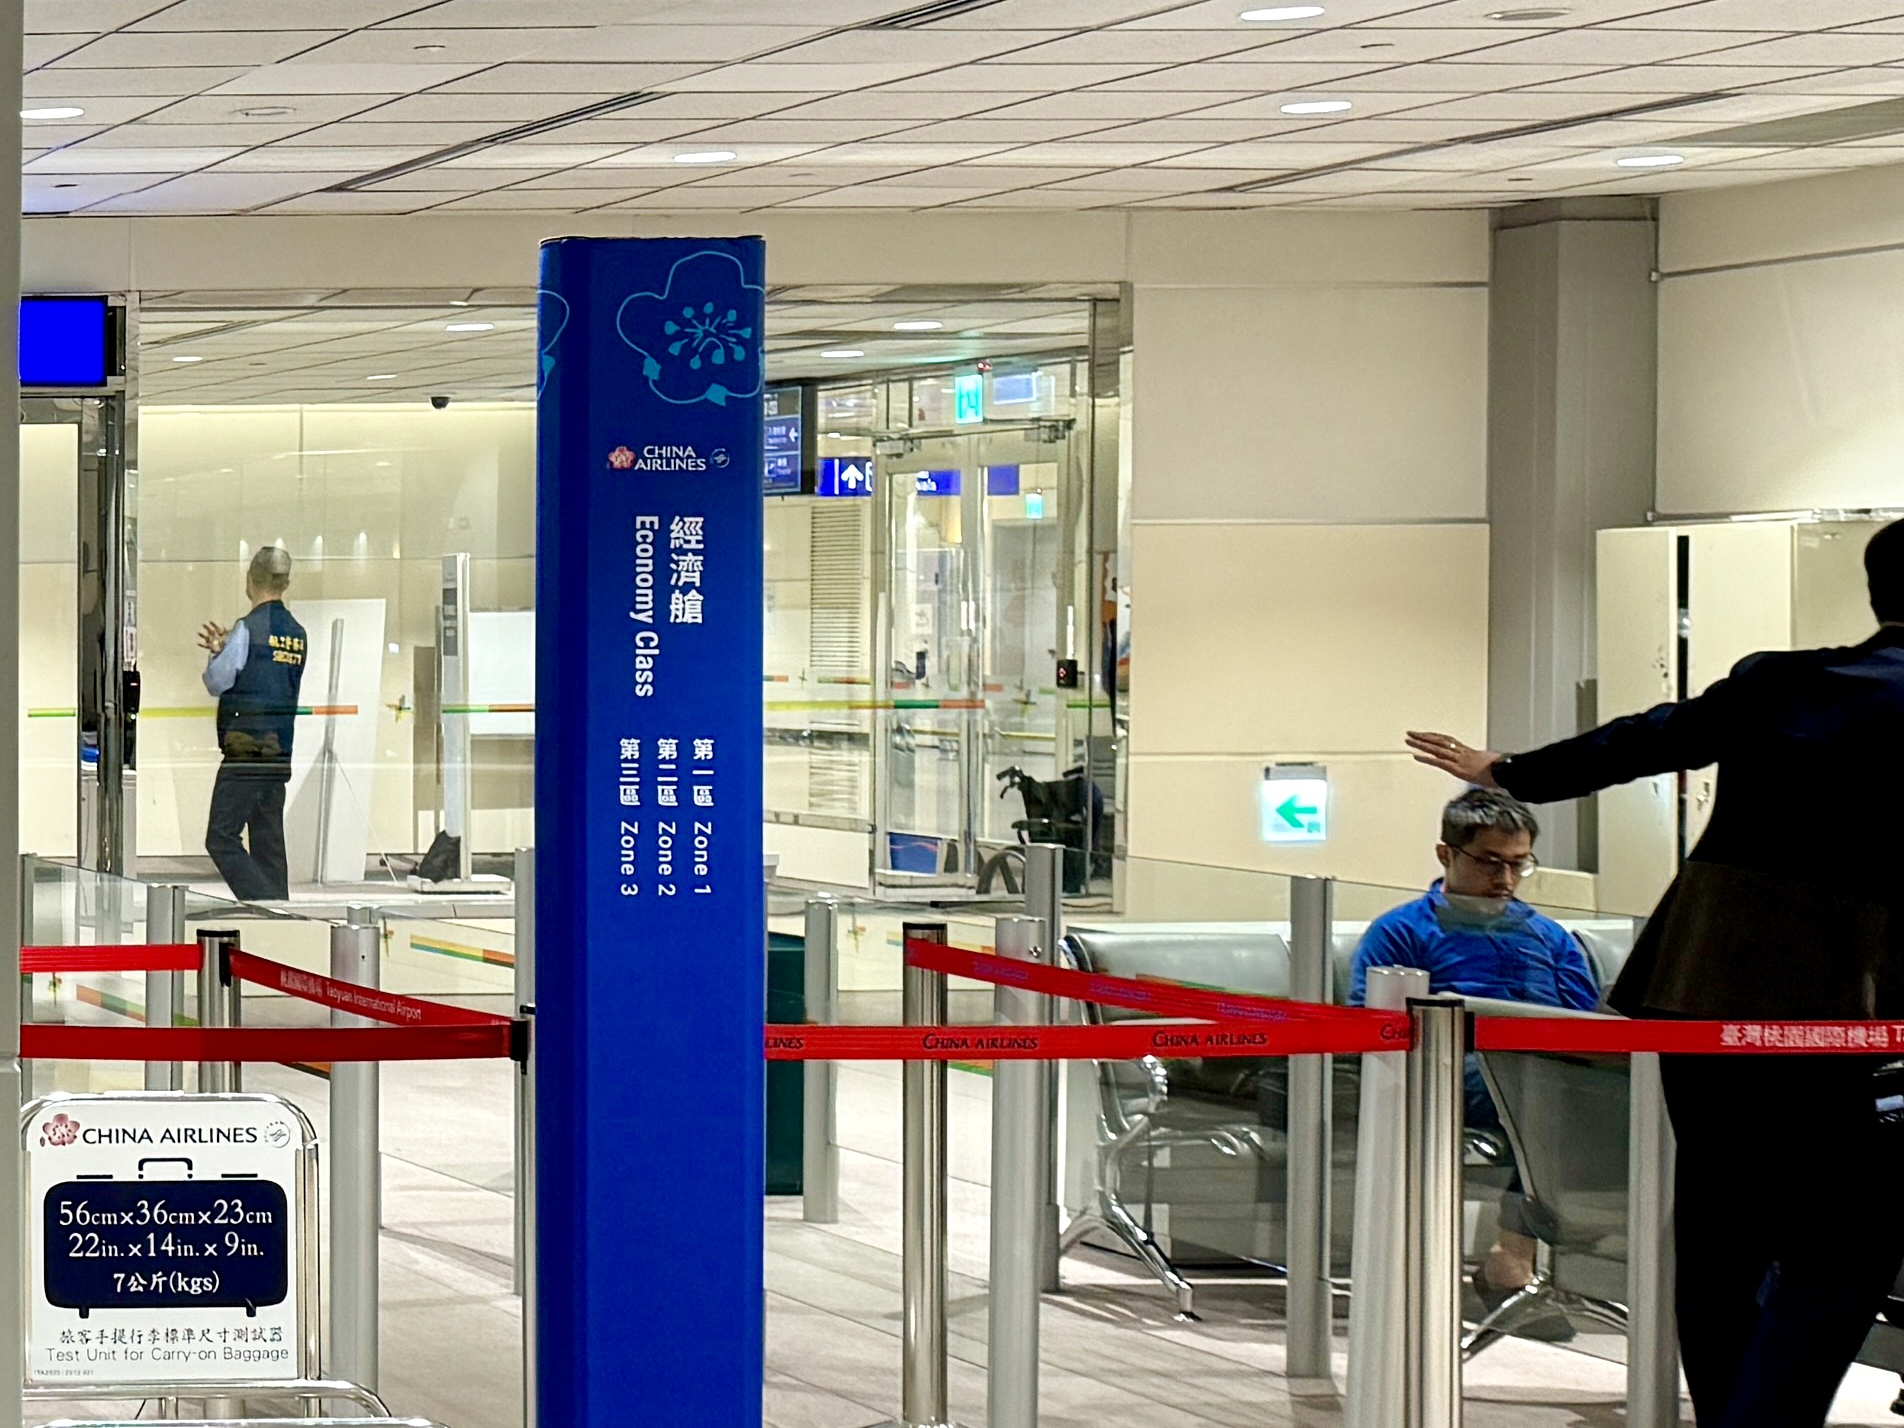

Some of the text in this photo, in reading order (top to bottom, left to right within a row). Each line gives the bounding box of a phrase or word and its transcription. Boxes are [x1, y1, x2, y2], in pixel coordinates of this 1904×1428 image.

[634, 458, 707, 471] AIRLINES
[643, 445, 697, 458] CHINA
[629, 515, 660, 697] Economy Class
[669, 515, 705, 624] 經濟艙
[619, 738, 641, 896] 第三區 Zone 3
[657, 738, 679, 896] 第二區 Zone 2
[692, 738, 715, 894] 第一區 Zone 1
[82, 1126, 258, 1145] CHINA AIRLINES
[46, 1347, 289, 1363] Test Unit for Carry-on Baggage
